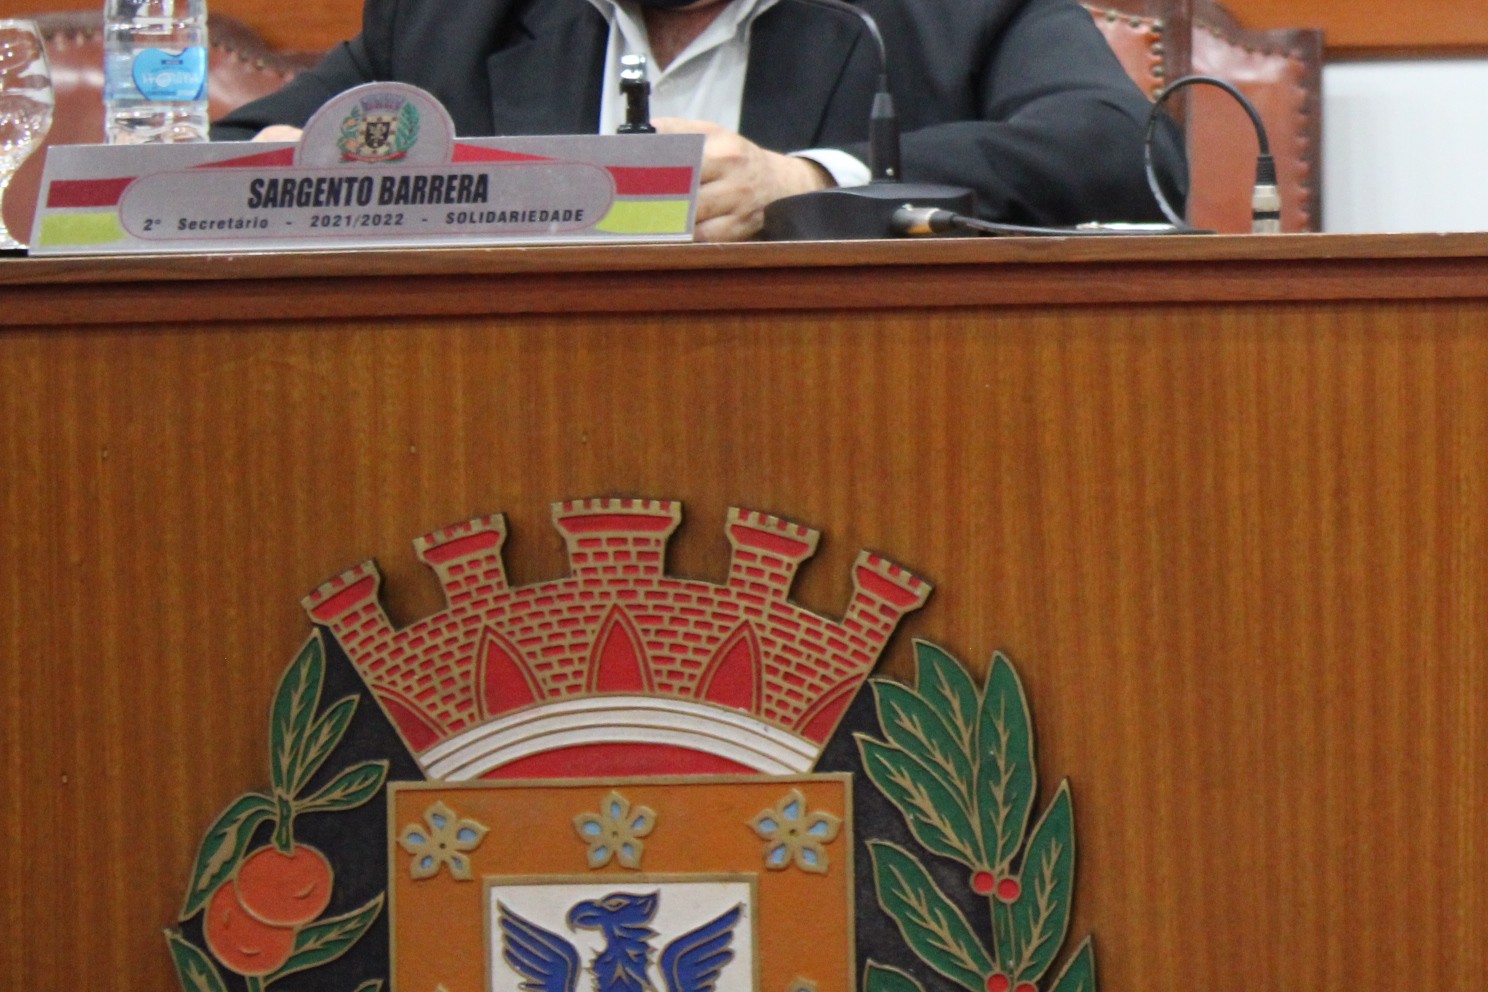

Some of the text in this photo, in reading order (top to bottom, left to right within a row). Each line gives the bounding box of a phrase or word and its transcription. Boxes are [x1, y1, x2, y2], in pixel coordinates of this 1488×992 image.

[248, 173, 489, 208] SARGENTO BARRERA
[310, 213, 404, 227] 2021/2022
[445, 209, 585, 224] SOLIDARIEDADE
